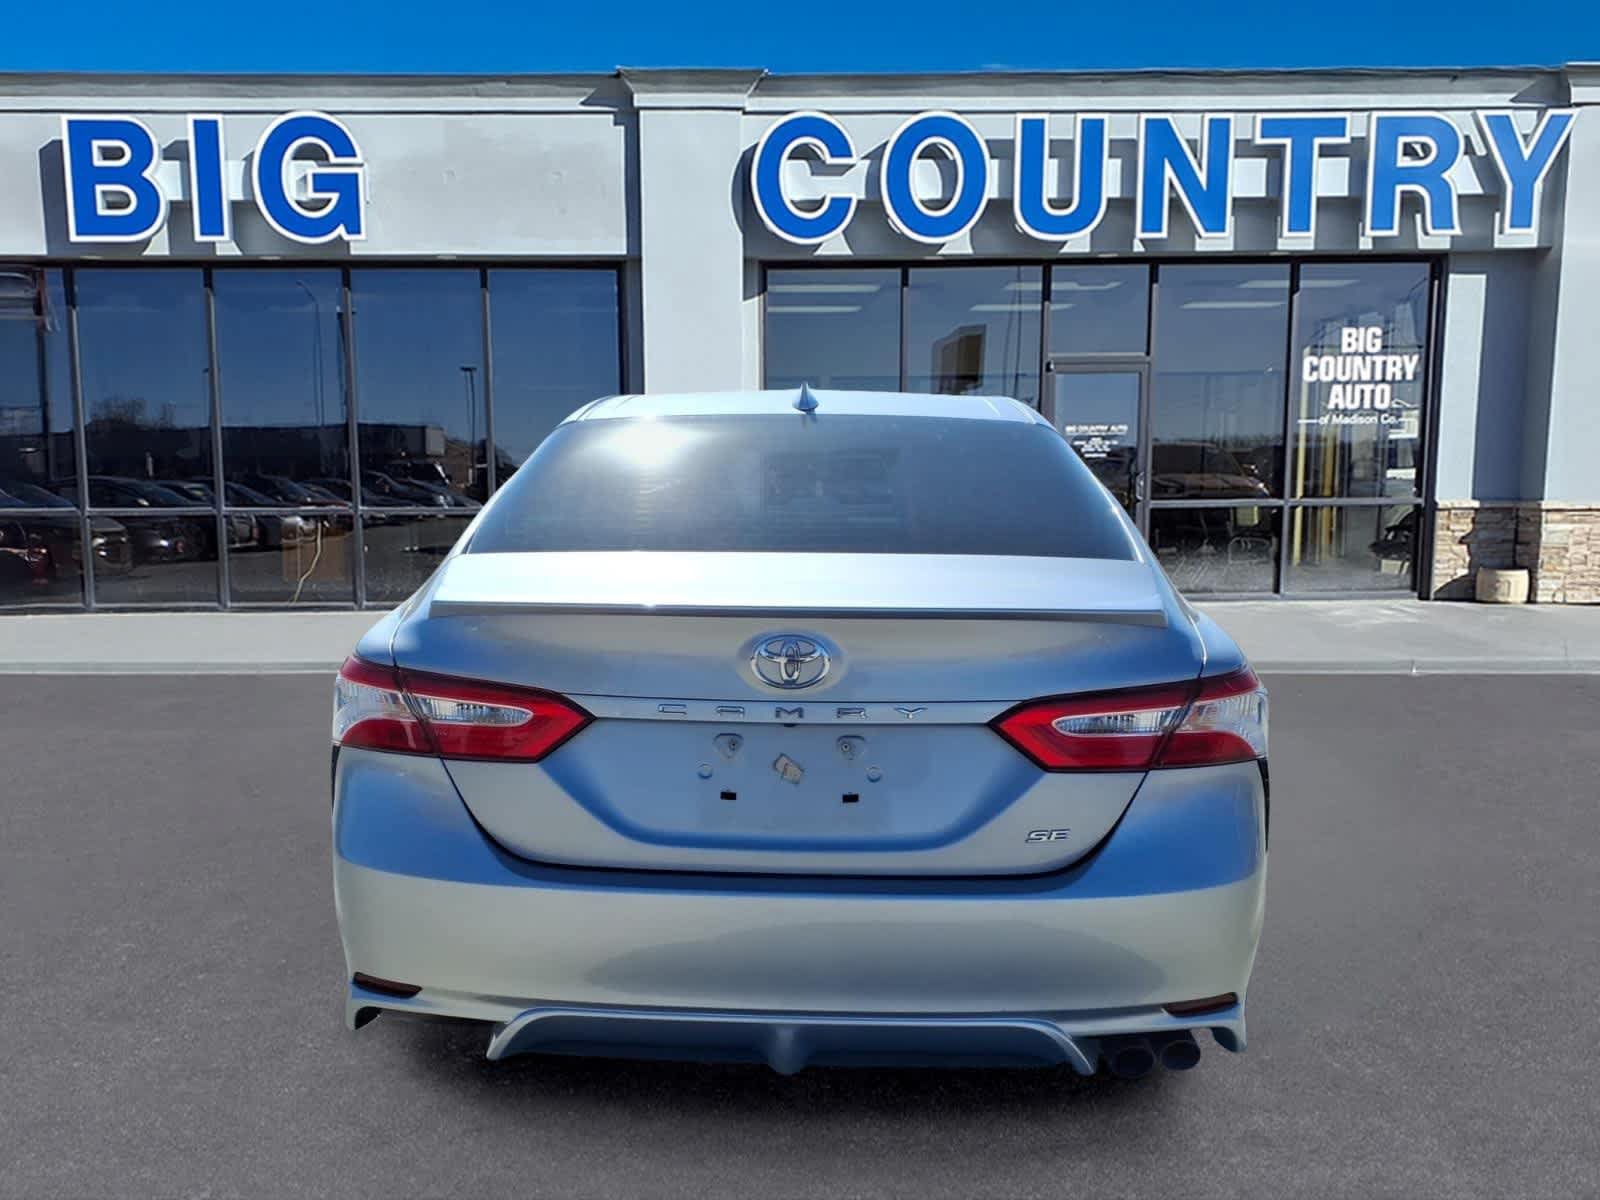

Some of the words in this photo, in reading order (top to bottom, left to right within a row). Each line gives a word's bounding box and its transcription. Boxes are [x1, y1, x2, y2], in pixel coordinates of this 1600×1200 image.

[60, 110, 366, 244] BIG
[750, 109, 1574, 245] COUNTRY
[1341, 327, 1383, 353] BIG
[1303, 355, 1420, 382] COUNTRY
[1327, 384, 1392, 410] AUTO
[1331, 413, 1378, 424] Madison
[657, 703, 927, 719] CAMRY
[1025, 828, 1071, 843] SE
